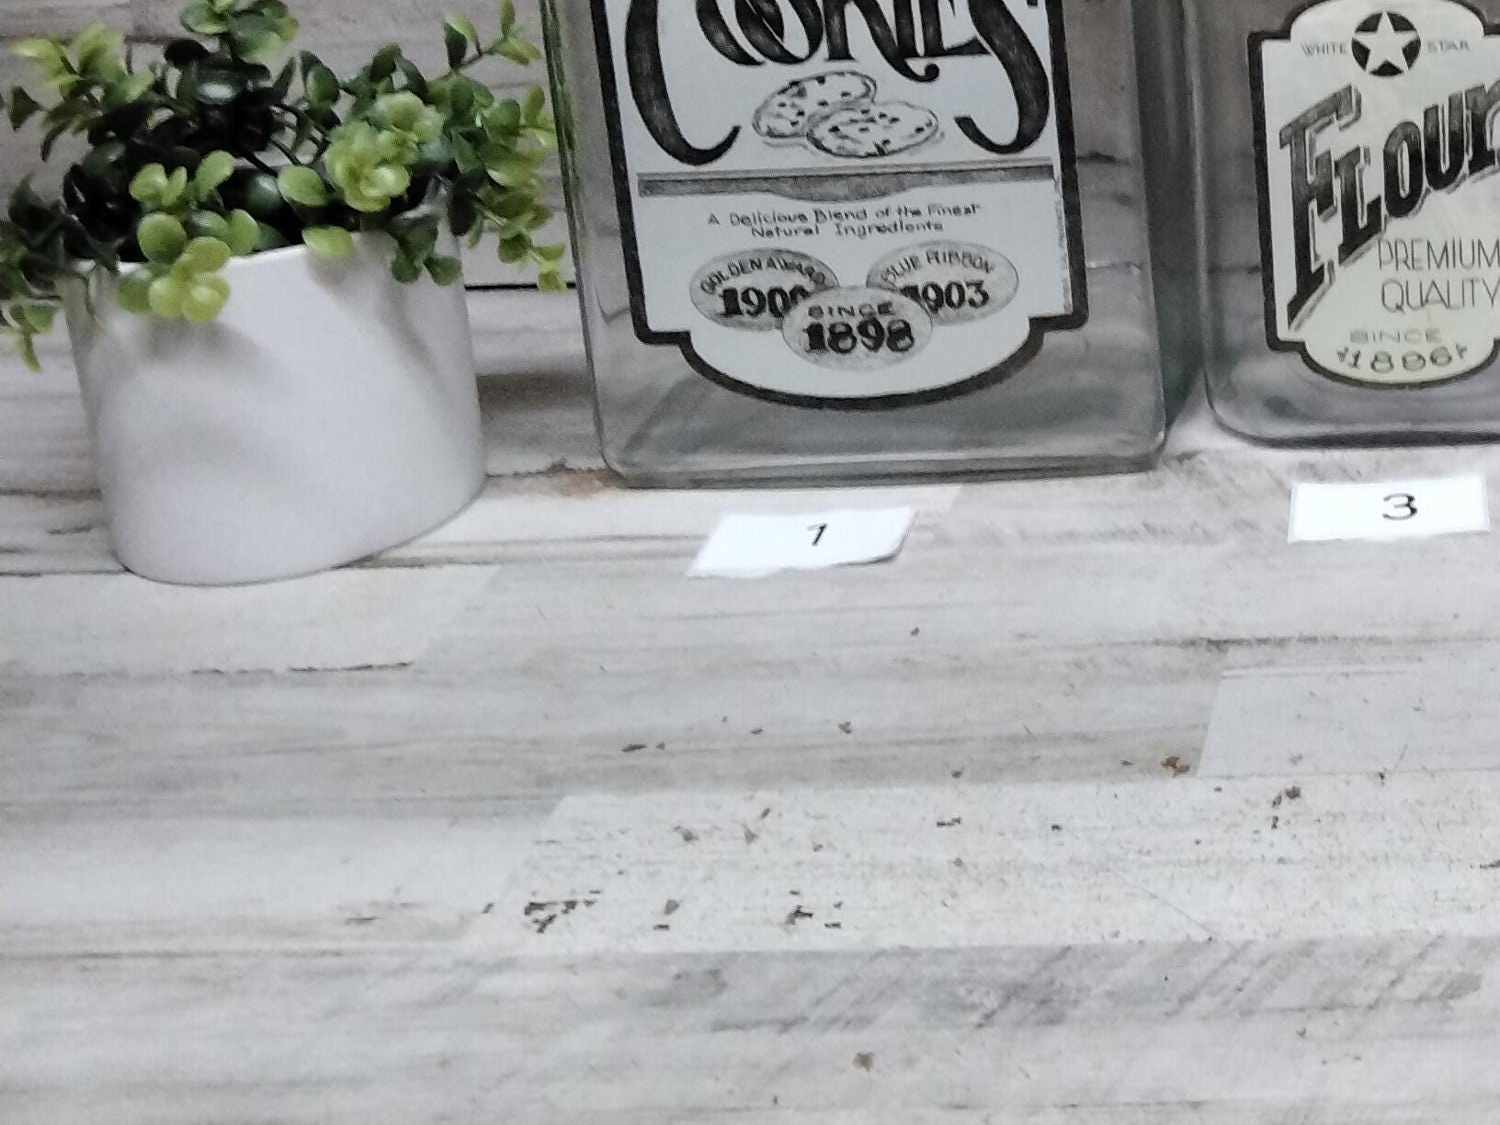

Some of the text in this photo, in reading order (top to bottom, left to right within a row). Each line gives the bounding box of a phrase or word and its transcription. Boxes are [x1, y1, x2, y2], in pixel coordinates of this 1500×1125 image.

[1302, 40, 1470, 57] WHITE STAR
[708, 214, 721, 225] A
[730, 210, 808, 227] Delicious
[814, 208, 867, 224] Blend
[875, 205, 891, 219] of
[897, 204, 922, 217] the
[751, 220, 944, 239] Natural Ingredients
[1376, 238, 1500, 271] PREMIUM
[1381, 277, 1500, 314] QUALITY
[808, 301, 897, 319] SINCE
[805, 318, 915, 354] 1898
[1350, 328, 1442, 344] SINCE
[1383, 494, 1419, 521] 3
